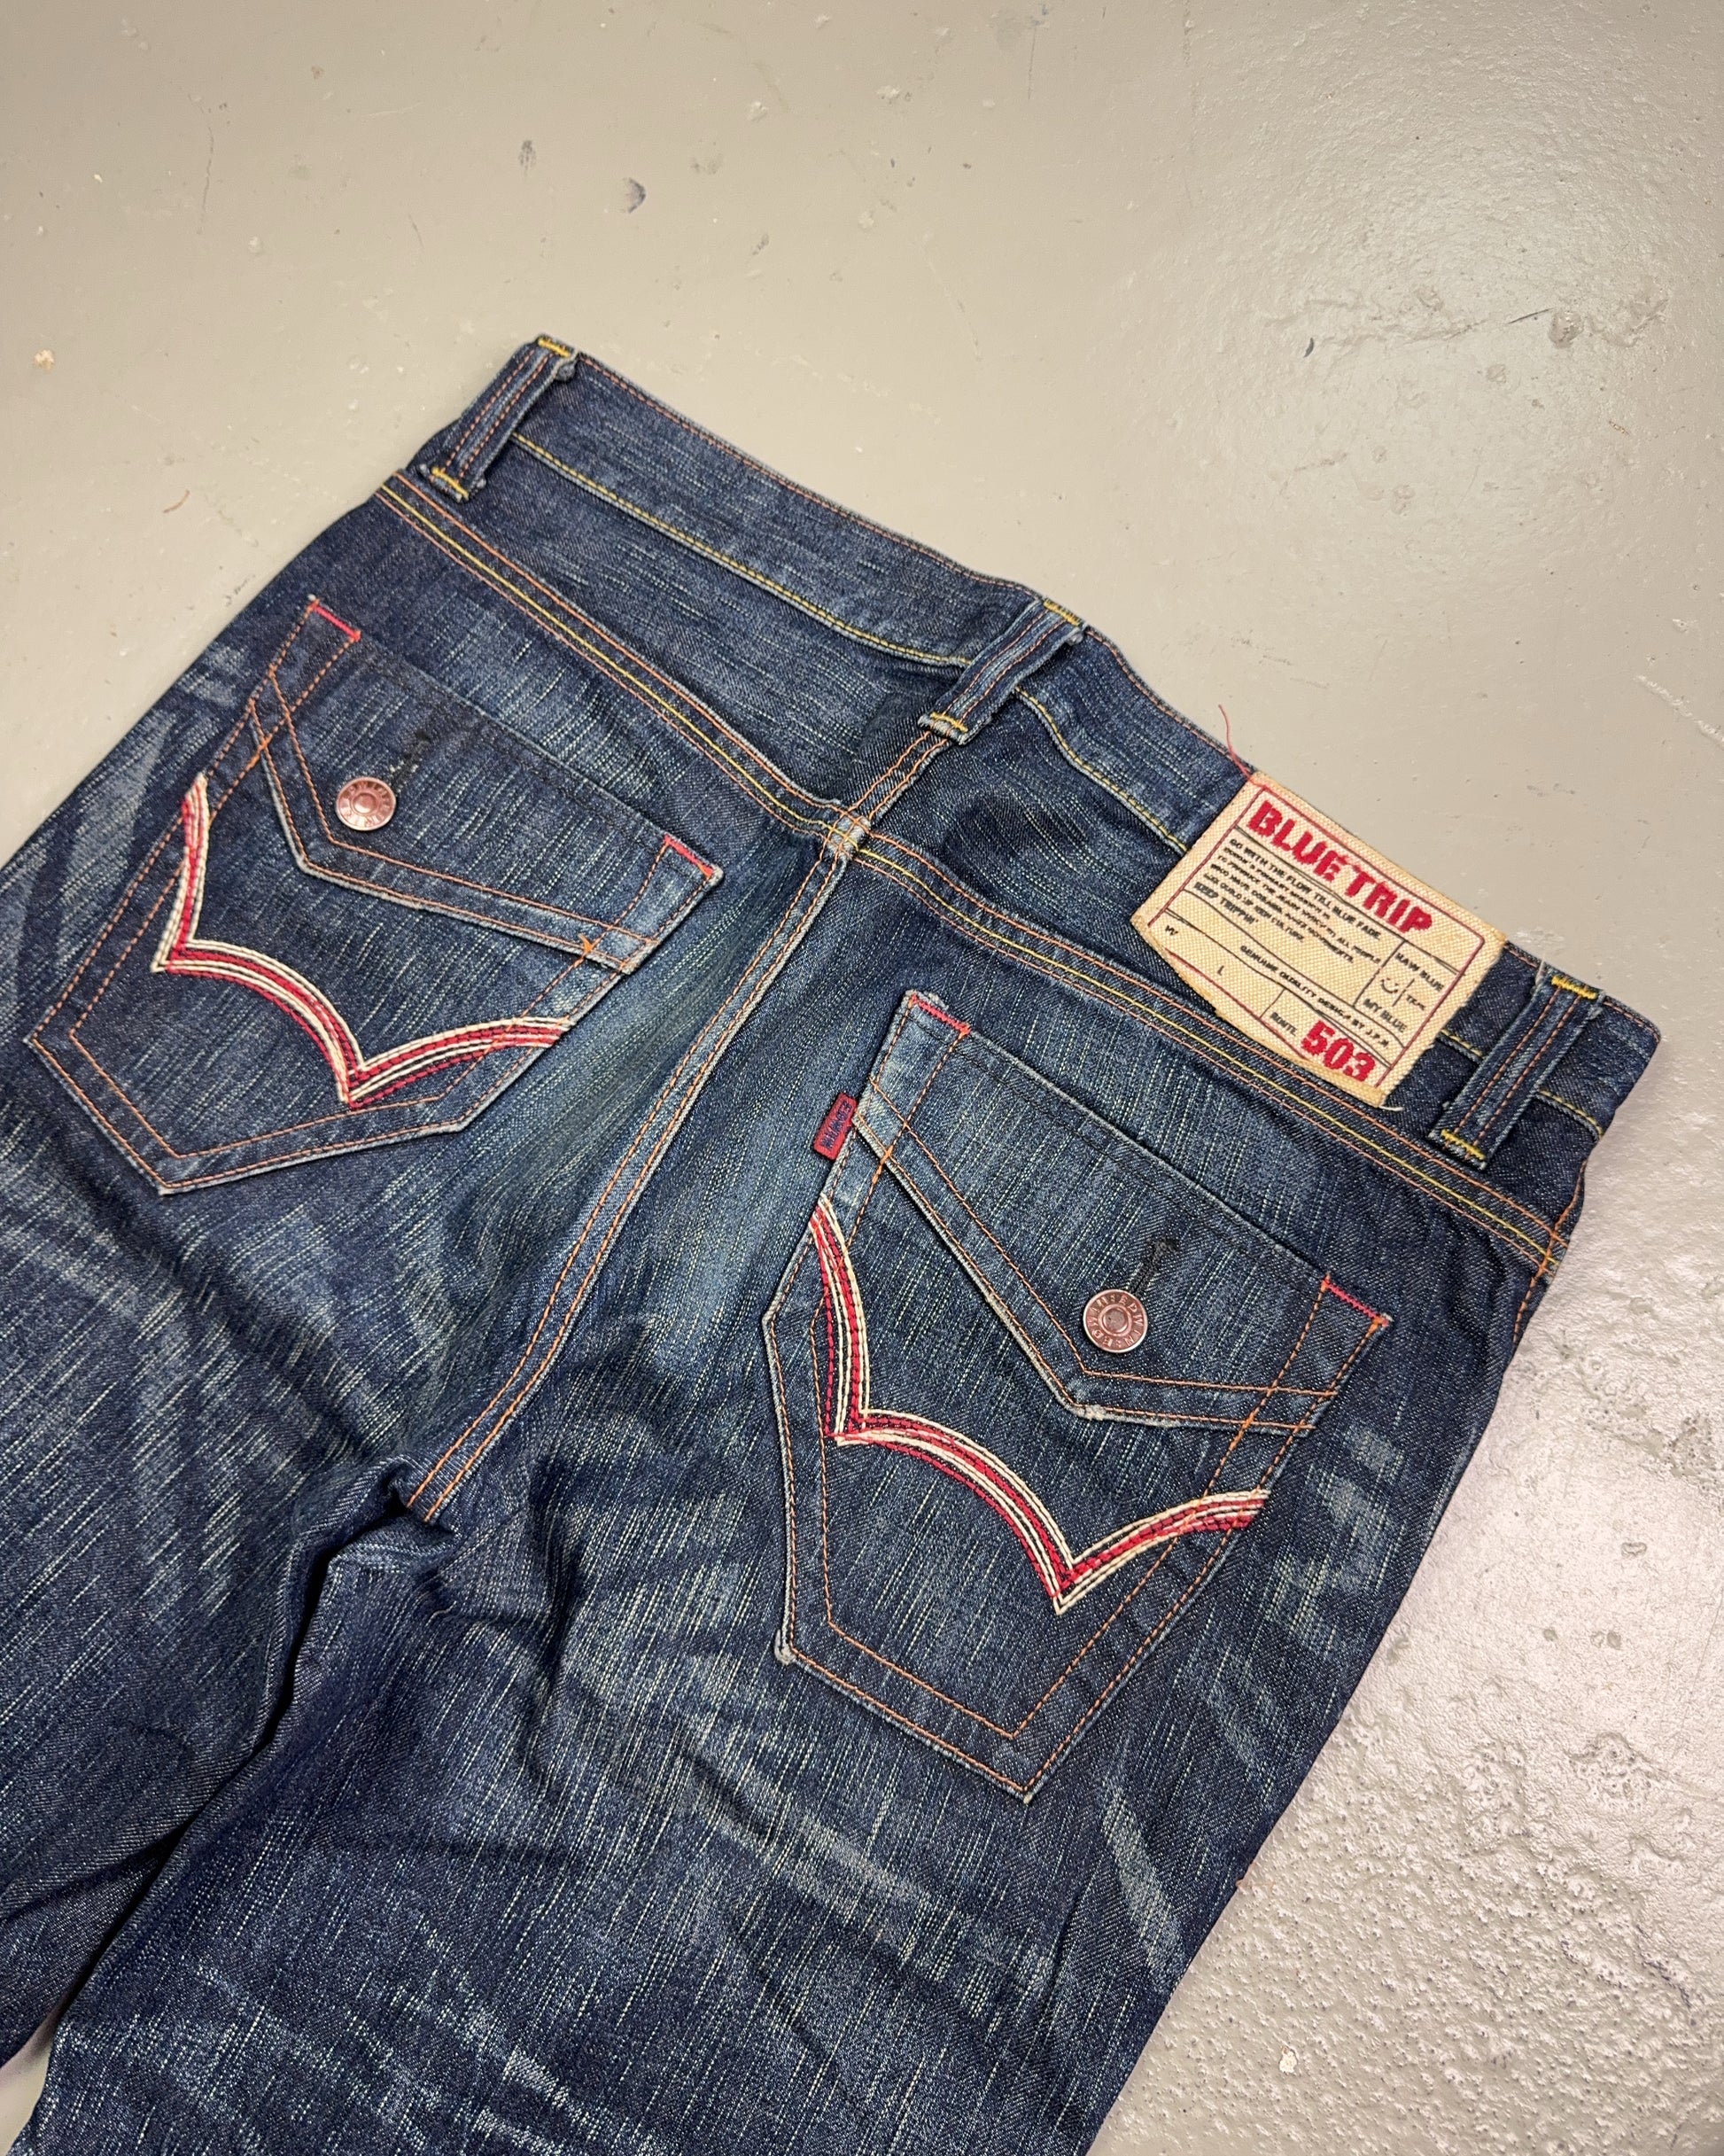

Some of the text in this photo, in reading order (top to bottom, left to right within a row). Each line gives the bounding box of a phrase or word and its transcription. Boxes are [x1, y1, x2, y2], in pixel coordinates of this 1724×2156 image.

[1193, 881, 1220, 899] KEEP
[1229, 838, 1244, 850] GO
[1243, 846, 1269, 867] WITH
[1268, 863, 1285, 879] THE
[1285, 875, 1313, 895] FLOW
[1332, 906, 1357, 924] BLUE
[1164, 924, 1225, 977] W L
[1394, 952, 1445, 992] RAW BLUE
[1239, 945, 1279, 973] GENUINE
[1278, 971, 1317, 998] QUALITY
[1351, 1018, 1365, 1030] BY
[1363, 998, 1383, 1014] MY
[1379, 1009, 1408, 1033] BLUE
[1270, 1011, 1376, 1082] ROUTE 503
